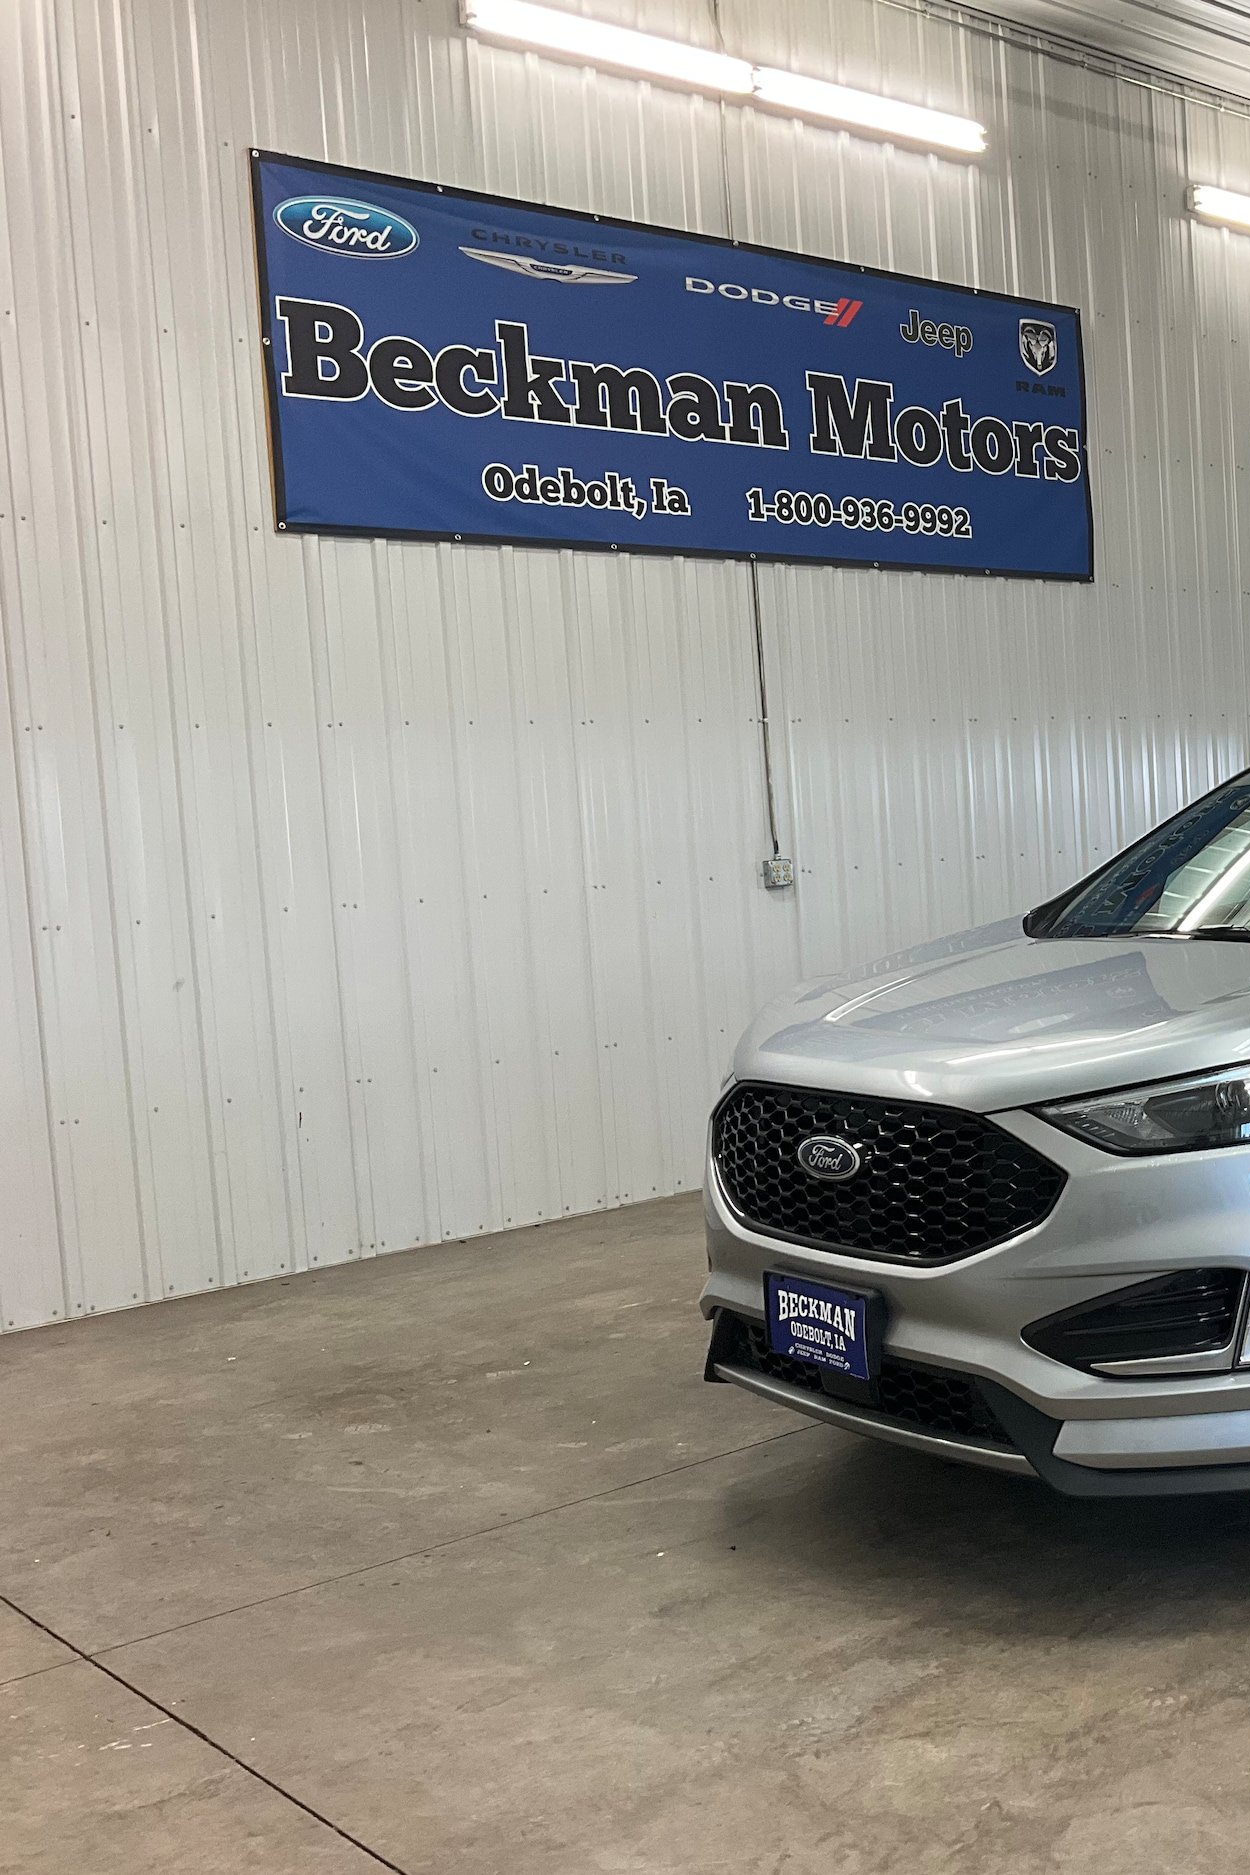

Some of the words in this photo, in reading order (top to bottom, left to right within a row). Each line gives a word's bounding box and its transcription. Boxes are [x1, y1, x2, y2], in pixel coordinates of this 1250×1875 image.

[302, 203, 393, 252] Ford
[470, 227, 628, 266] CHRYSLER
[685, 276, 839, 316] DODGE
[899, 309, 973, 358] Jeep
[275, 296, 789, 450] Beckman
[805, 370, 1081, 483] Motors
[1015, 380, 1066, 398] RAM
[482, 462, 647, 519] Odebolt,
[650, 478, 691, 516] Ia
[746, 487, 972, 538] 1-800-936-9992
[808, 1144, 843, 1170] Ford
[778, 1289, 856, 1341] BECKMAN
[790, 1321, 834, 1349] ODEBOLT,
[834, 1334, 846, 1351] IA
